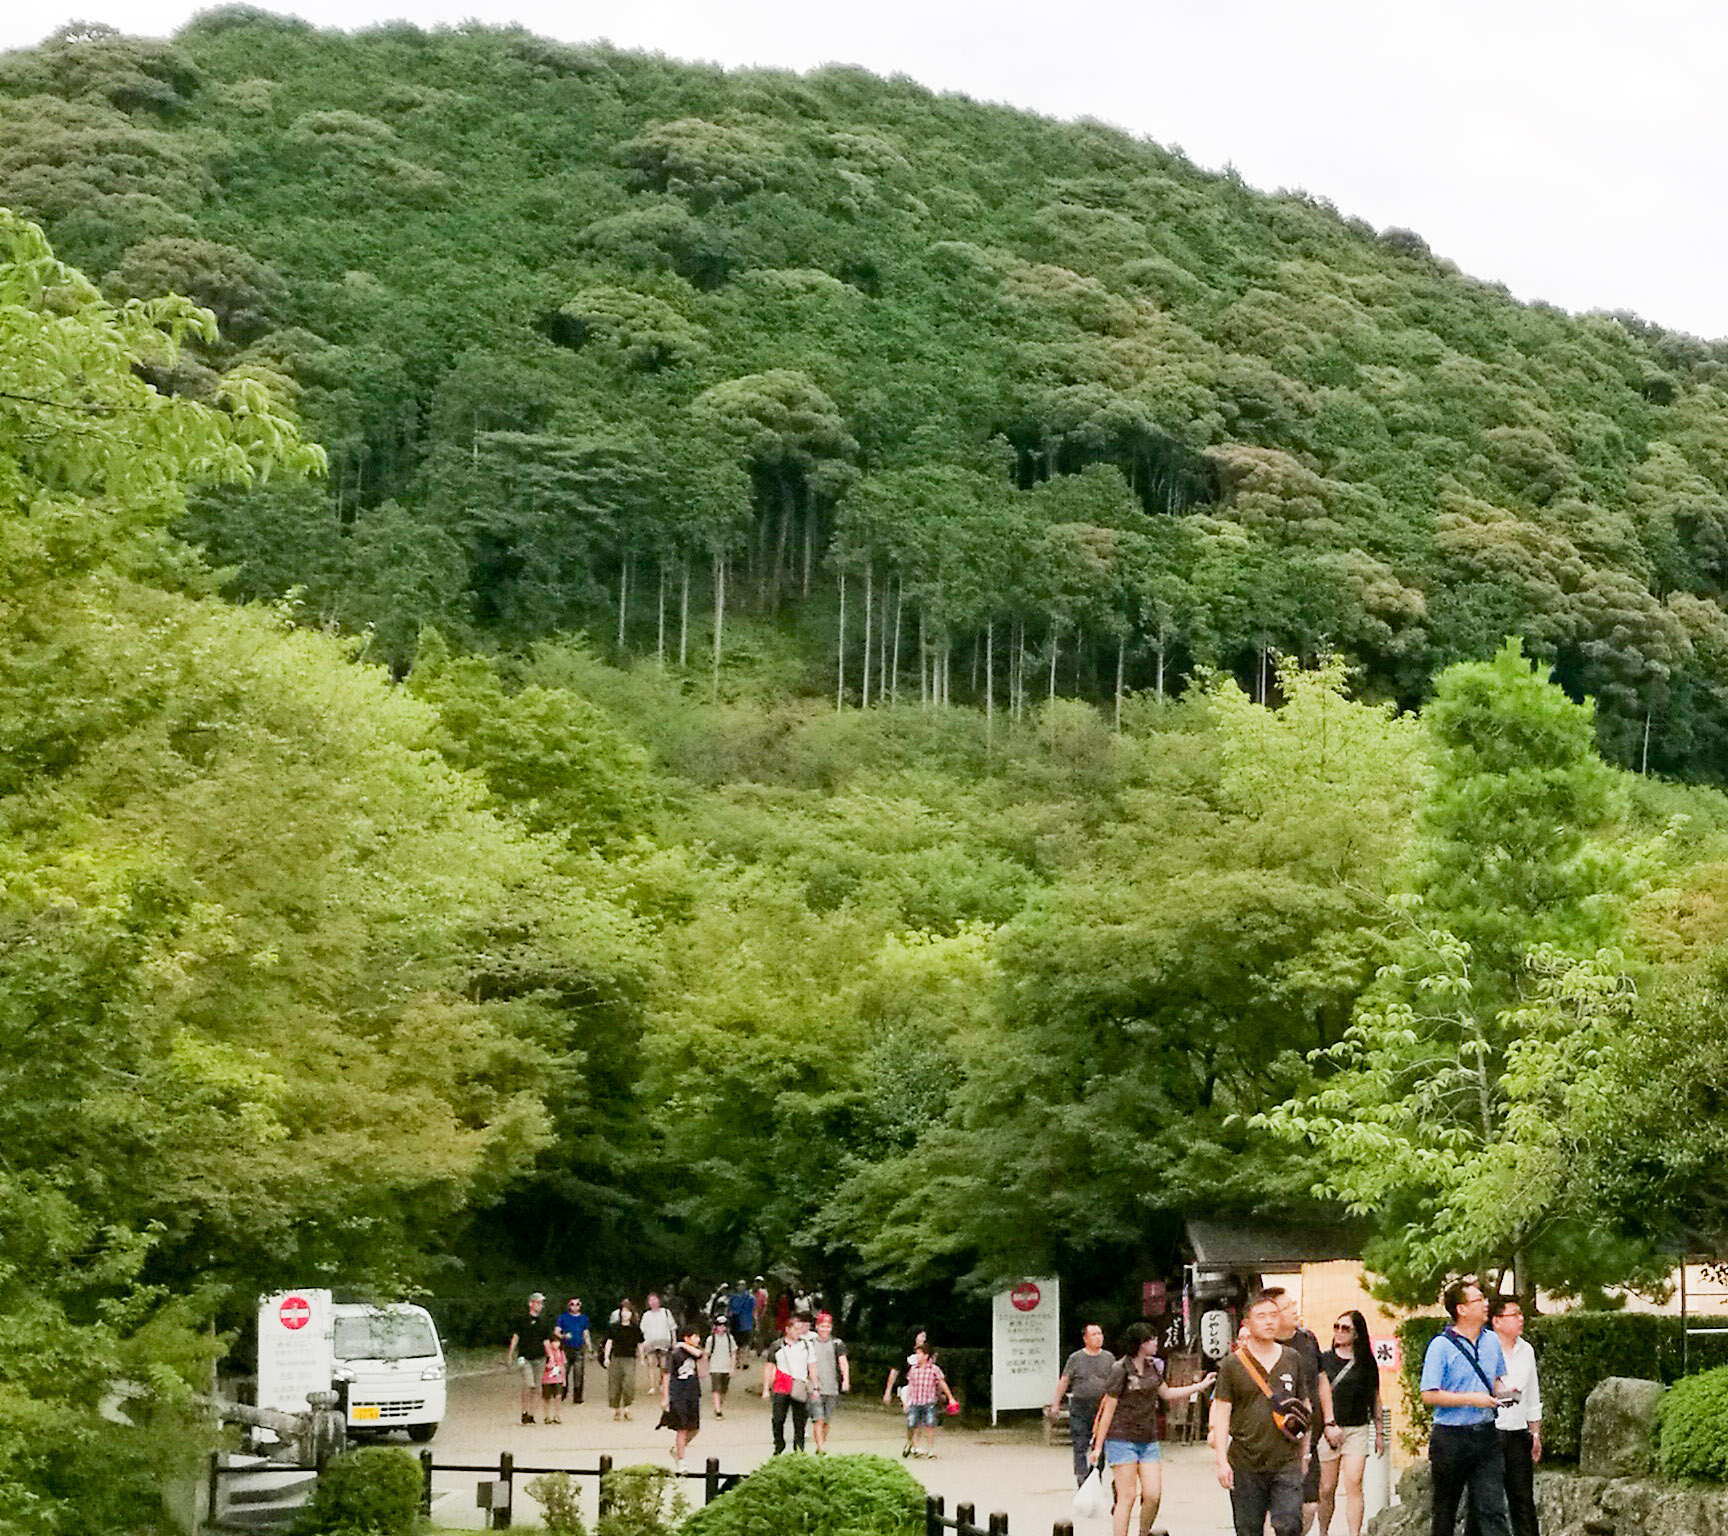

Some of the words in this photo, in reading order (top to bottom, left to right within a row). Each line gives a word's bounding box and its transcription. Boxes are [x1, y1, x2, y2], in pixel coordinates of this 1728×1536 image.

[1209, 1314, 1220, 1355] ひやしあめ
[1377, 1344, 1393, 1361] 氷
